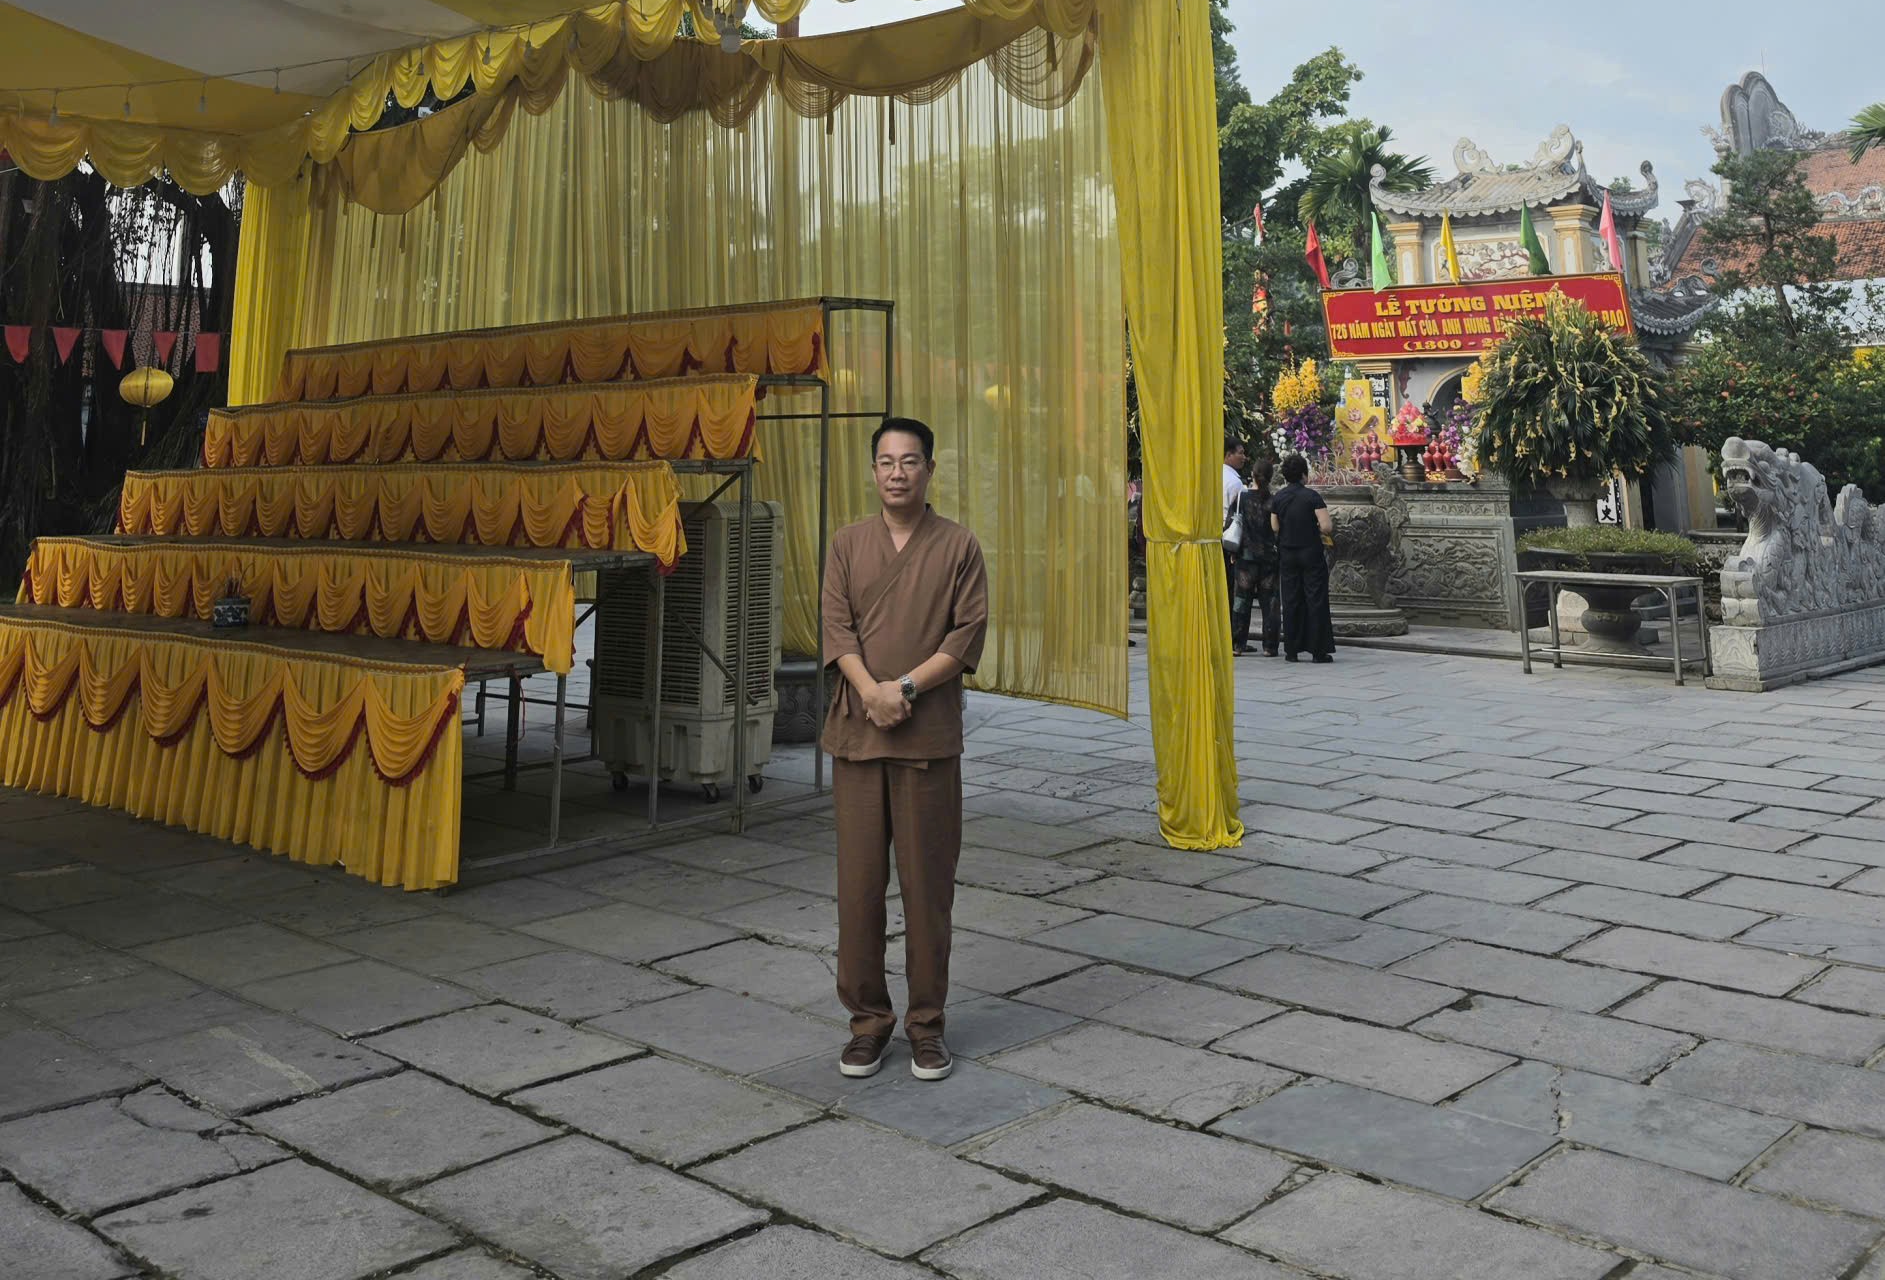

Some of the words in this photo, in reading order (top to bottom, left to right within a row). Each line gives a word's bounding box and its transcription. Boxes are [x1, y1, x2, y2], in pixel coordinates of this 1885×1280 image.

[1375, 295, 1402, 316] LỄ
[1405, 294, 1486, 314] TƯỞNG
[1331, 324, 1348, 340] 726
[1349, 319, 1370, 339] NĂM
[1372, 318, 1396, 338] NGÀY
[1398, 316, 1418, 337] MẤT
[1420, 315, 1439, 336] CỦA
[1442, 318, 1462, 335] ANH
[1465, 314, 1491, 334] HÙNG
